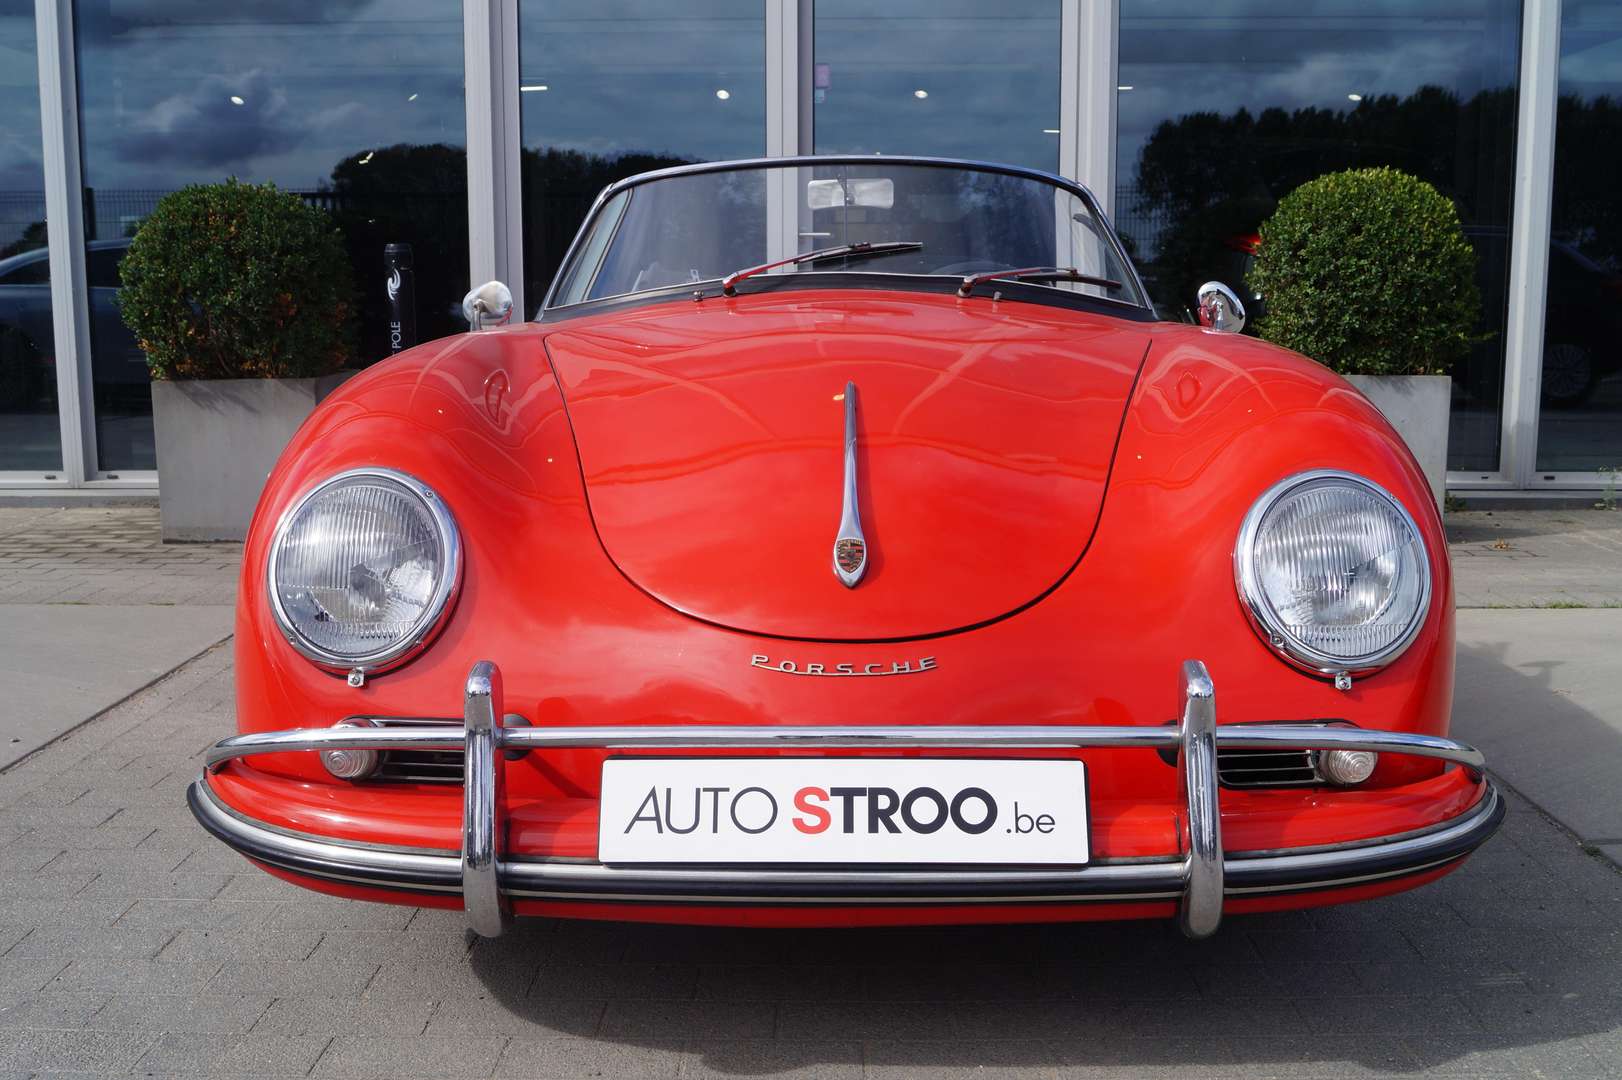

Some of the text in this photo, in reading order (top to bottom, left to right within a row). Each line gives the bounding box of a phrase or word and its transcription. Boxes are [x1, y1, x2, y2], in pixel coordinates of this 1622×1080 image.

[391, 321, 402, 348] POLE
[751, 654, 937, 676] PORSCHE
[623, 786, 778, 835] AUTO
[791, 786, 998, 835] STROO
